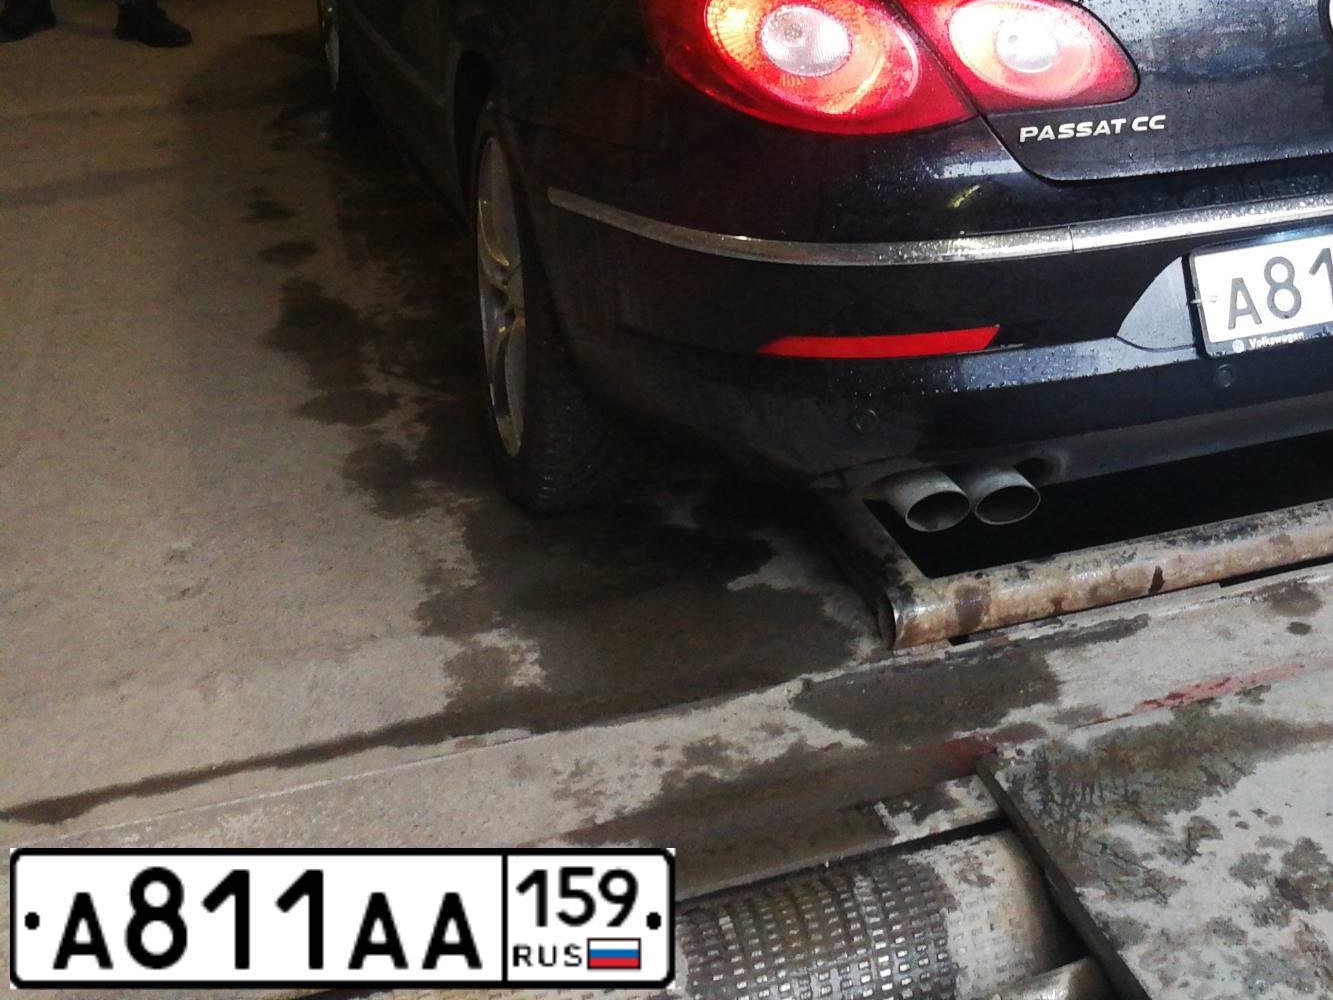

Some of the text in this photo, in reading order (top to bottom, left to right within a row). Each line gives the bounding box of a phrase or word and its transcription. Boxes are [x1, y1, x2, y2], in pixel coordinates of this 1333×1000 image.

[1019, 114, 1167, 142] PASSAT CC
[1248, 331, 1305, 350] Volkswagen
